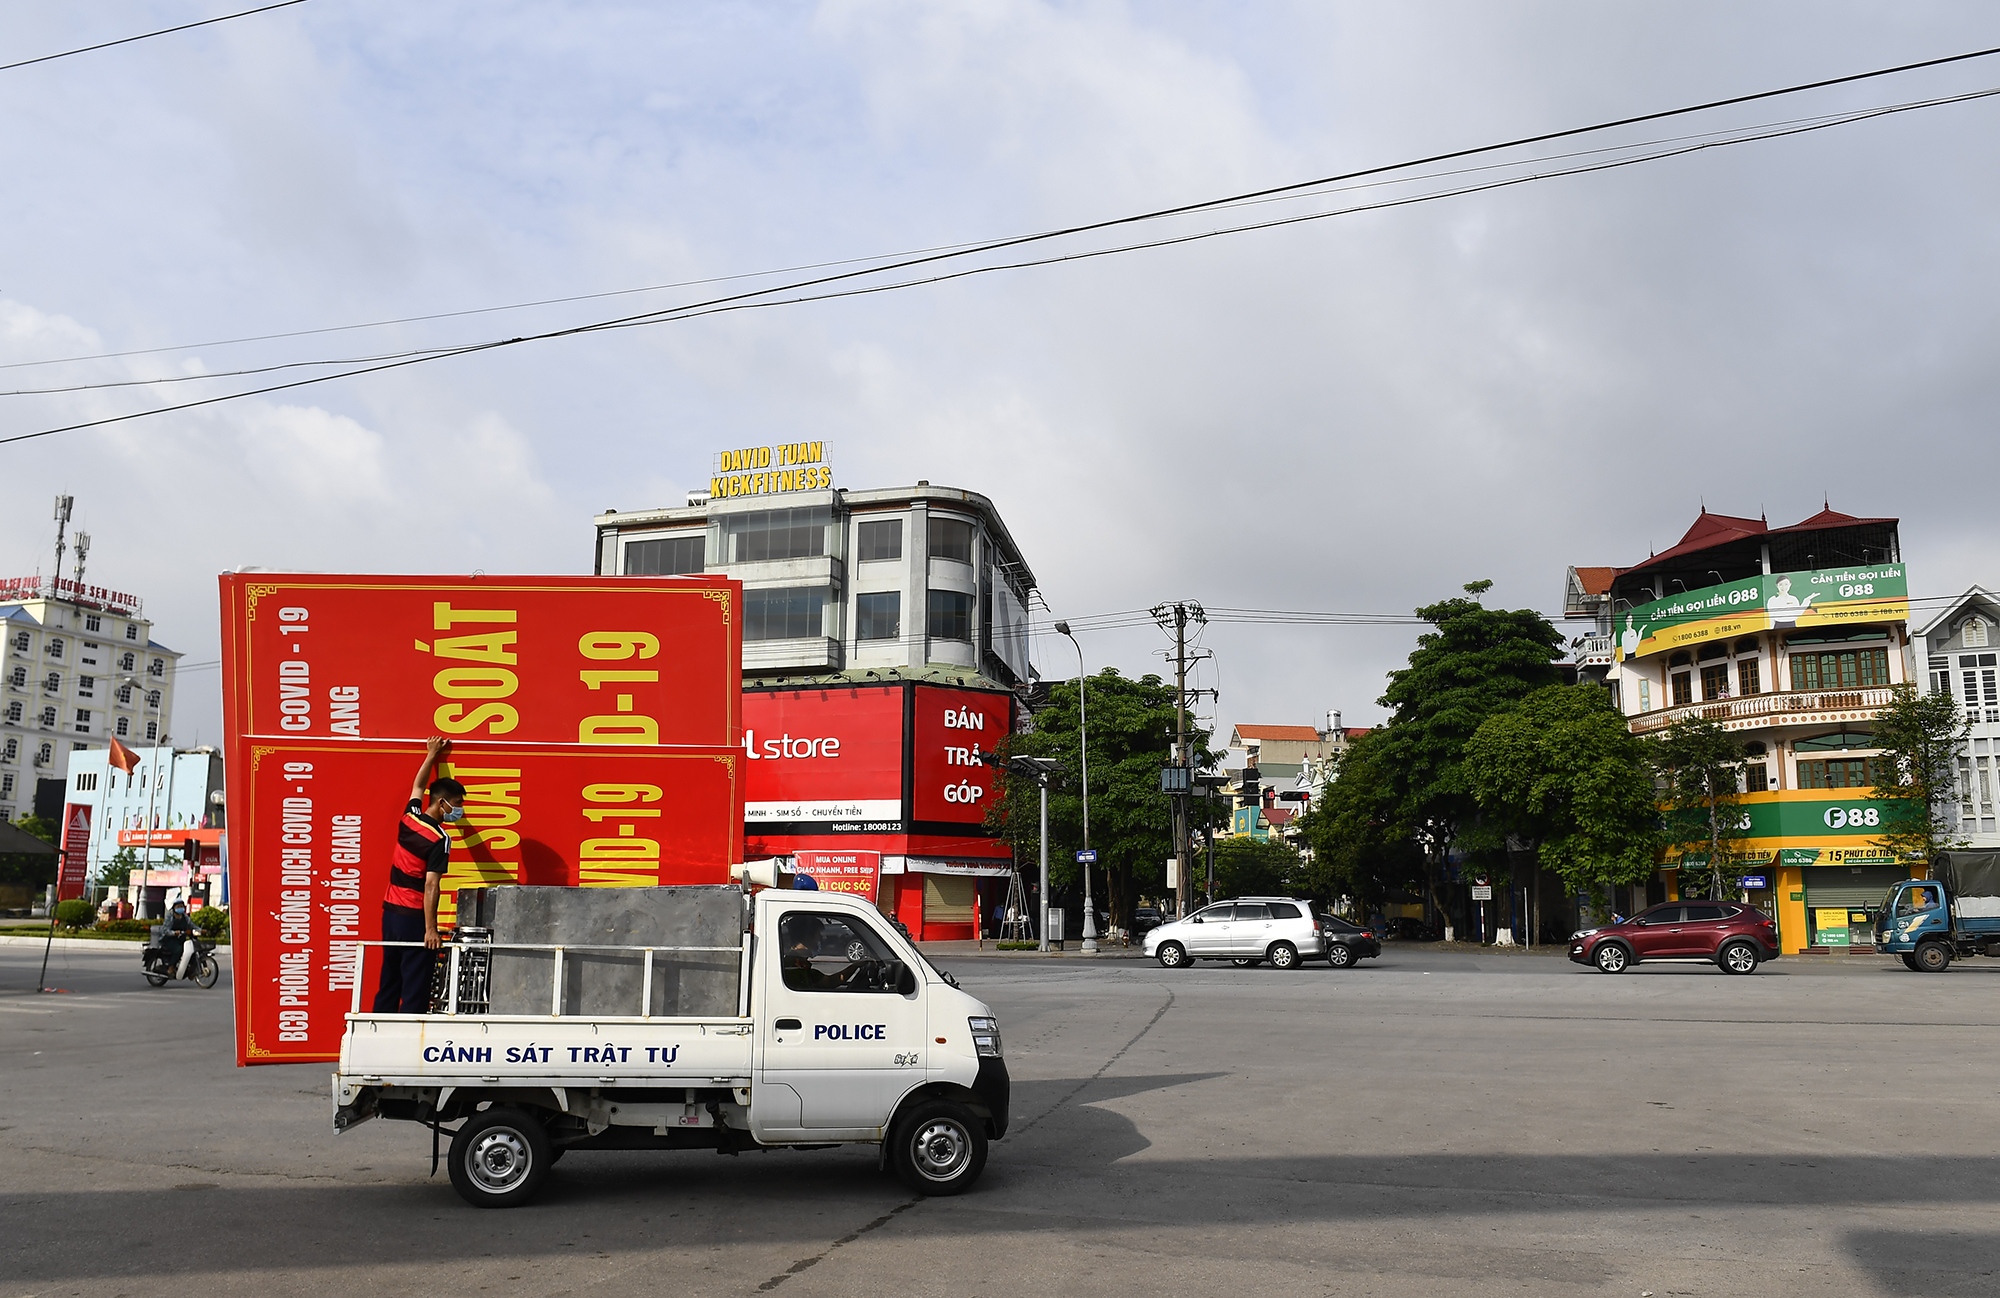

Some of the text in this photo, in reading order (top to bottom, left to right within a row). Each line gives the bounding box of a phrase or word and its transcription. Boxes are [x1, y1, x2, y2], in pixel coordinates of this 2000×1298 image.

[721, 441, 822, 472] DAVID TUAN
[710, 466, 831, 498] KICKFITNESS
[1810, 573, 1833, 584] CẦN
[1858, 571, 1878, 581] GỌI
[1880, 567, 1901, 579] LIỀN
[89, 585, 108, 600] SEN
[111, 591, 137, 607] HOTEL
[1728, 587, 1758, 605] F88
[1839, 583, 1874, 597] F88
[1686, 600, 1704, 612] GỌI
[1706, 593, 1726, 607] LIỀN
[278, 606, 309, 636] 19
[1721, 624, 1741, 633] f88.vn
[1677, 629, 1708, 641] 1800 6388
[414, 601, 519, 734] SOÁT
[279, 660, 311, 731] COVID
[329, 686, 360, 739] ANG
[943, 705, 984, 731] BÁN
[763, 733, 840, 760] store
[943, 743, 984, 767] TRẢ
[283, 762, 314, 781] 19
[943, 778, 984, 804] GÓP
[281, 797, 313, 844] COVID
[776, 809, 790, 817] SIM
[791, 805, 802, 817] SỐ
[811, 804, 843, 817] CHUYỂN
[845, 804, 863, 817] TIỀN
[1824, 807, 1880, 829] F88
[832, 822, 902, 832] Hotline: 18008123
[281, 848, 318, 886] DỊCH
[815, 855, 857, 864] MUA ONLINE
[1828, 850, 1842, 862] 15
[1843, 848, 1864, 857] PHÚT
[1866, 848, 1878, 857] CÓ
[796, 866, 815, 874] GIAO
[816, 866, 843, 875] NHANH,
[843, 866, 859, 874] FREE
[853, 878, 871, 891] SỐC
[319, 815, 362, 991] THÀNH PHỐ BẮC GIANG
[269, 890, 311, 944] CHỐNG
[271, 948, 314, 1006] PHÒNG,
[278, 1010, 309, 1042] BCĐ
[814, 1024, 887, 1040] POLICE
[423, 1040, 680, 1068] CẢNH SÁT TRẬT TỰ
